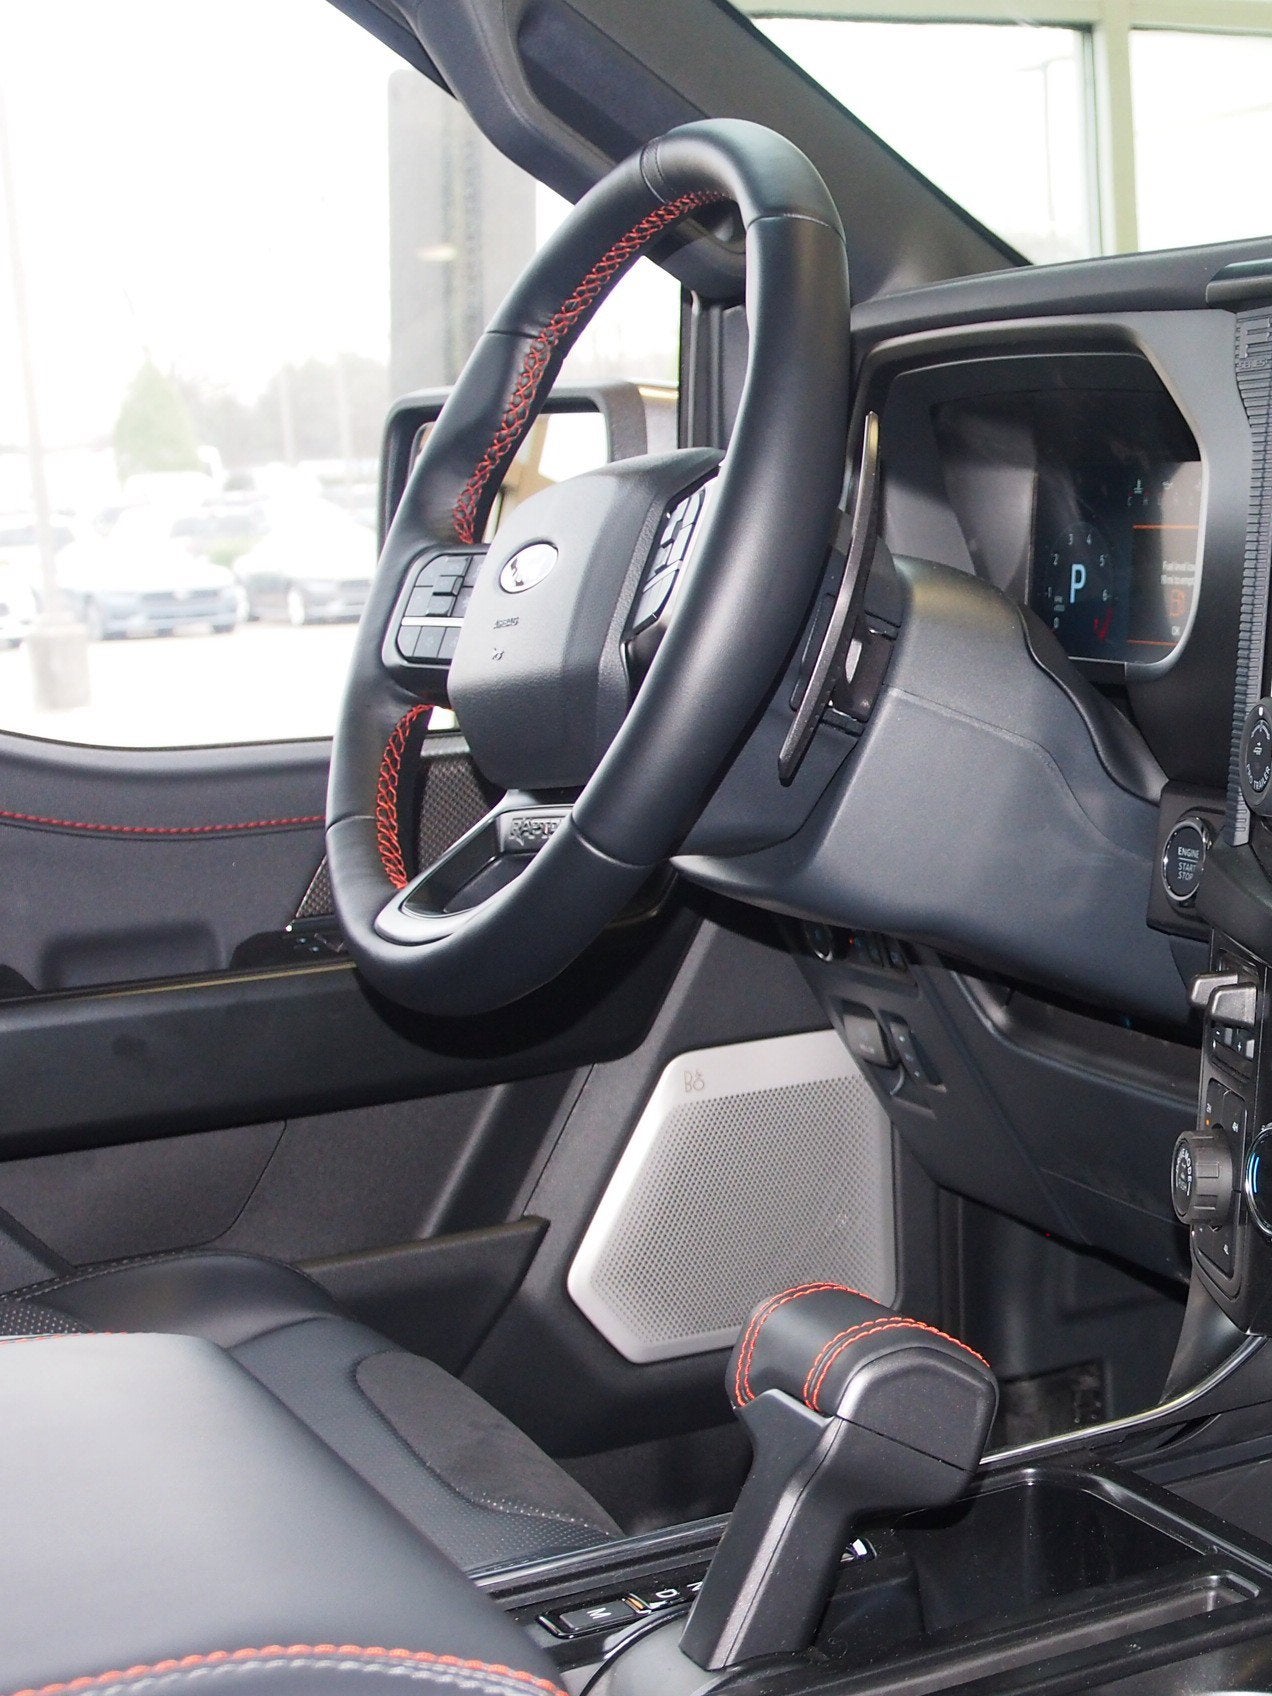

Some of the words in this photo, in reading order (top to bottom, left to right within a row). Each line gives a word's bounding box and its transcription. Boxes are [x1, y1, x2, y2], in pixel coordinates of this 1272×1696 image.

[1069, 563, 1087, 604] P
[1177, 846, 1199, 859] ENGINE
[1178, 861, 1197, 872] START
[1177, 871, 1194, 881] STOP
[655, 1588, 679, 1599] D
[586, 1607, 612, 1620] M
